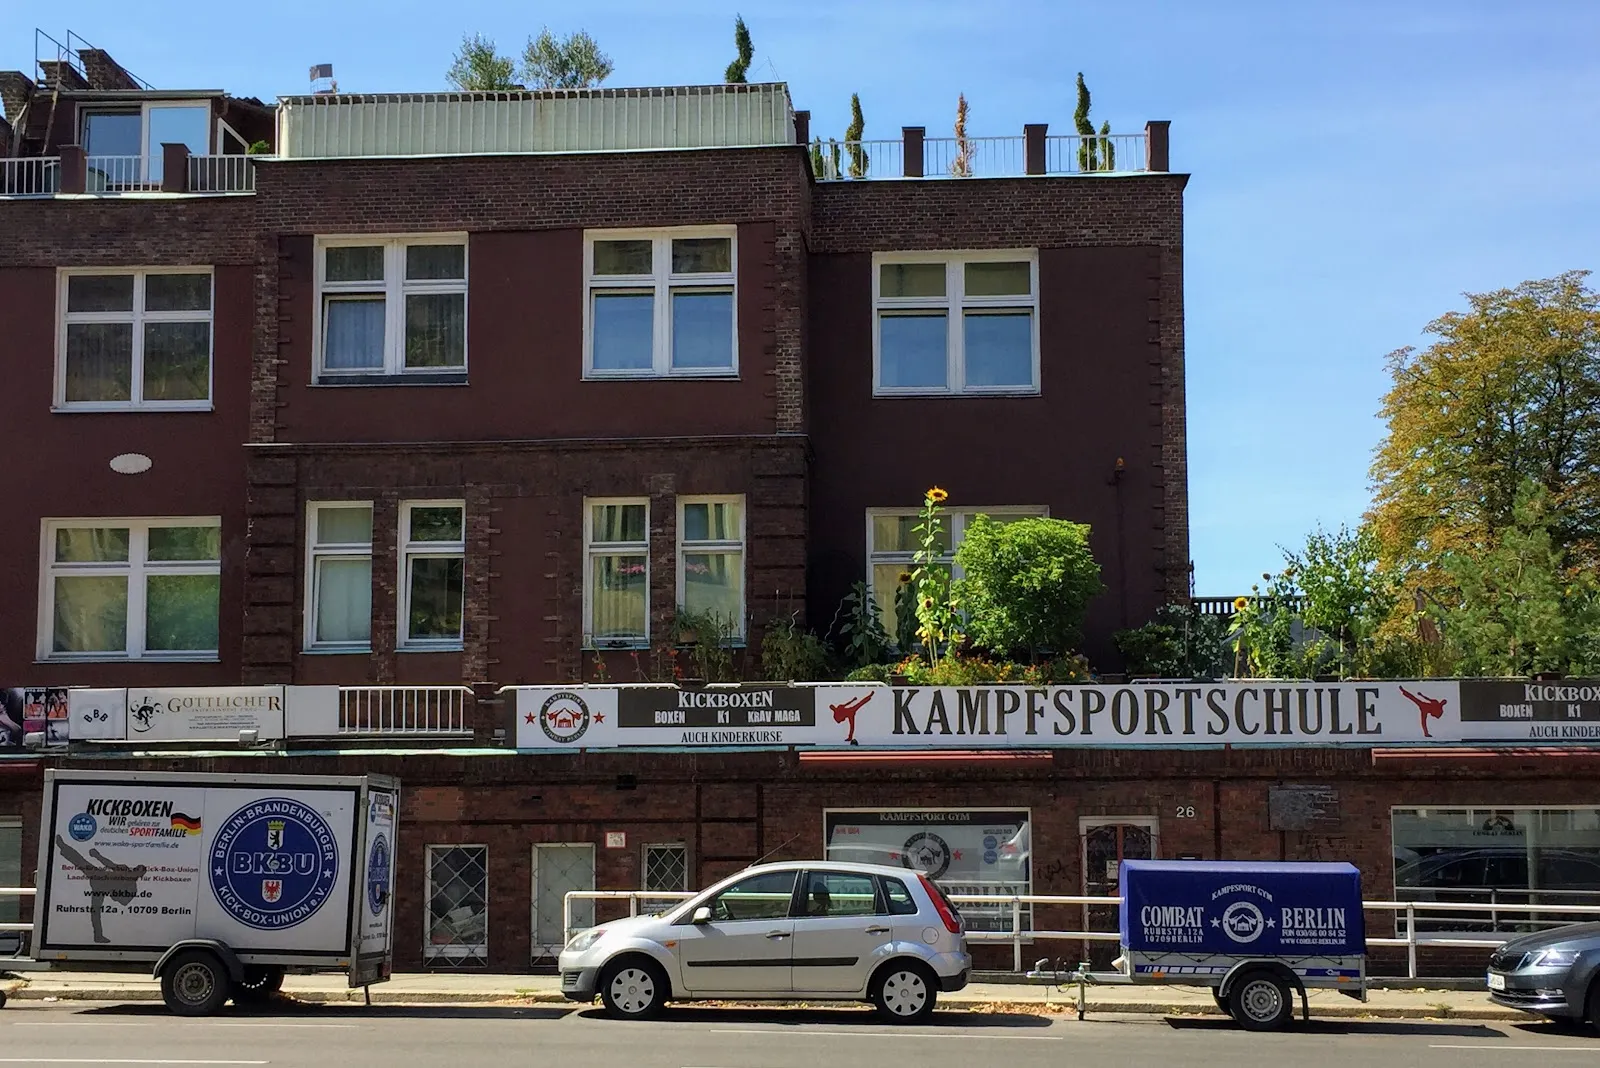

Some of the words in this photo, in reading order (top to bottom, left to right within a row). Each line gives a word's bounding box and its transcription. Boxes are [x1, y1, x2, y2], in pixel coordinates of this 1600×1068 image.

[677, 689, 774, 708] KICKBOXEN
[654, 710, 686, 724] BOXEN
[717, 710, 730, 724] K1
[747, 710, 772, 724] KRAV
[774, 709, 801, 723] MAGA
[891, 688, 1380, 736] KAMPFSPORTSCHULE
[1499, 704, 1533, 718] BOXEN
[1567, 704, 1582, 718] K1
[681, 731, 710, 744] AUCH
[711, 730, 783, 743] KINDERKURSE
[1529, 726, 1559, 738] AUCH
[86, 798, 174, 818] KICKBOXEN
[1176, 806, 1195, 818] 26
[108, 816, 127, 827] WIR
[879, 812, 947, 822] KAMPFSPORT
[948, 812, 971, 822] GYM
[129, 827, 187, 838] SPORTFAMILIE
[215, 802, 334, 861] BERLIN-BRANDENBURGER
[232, 851, 315, 876] BKBU
[153, 875, 191, 883] Kickboxen
[83, 889, 153, 899] www.bkbu.de
[1257, 888, 1273, 902] GYM
[56, 904, 95, 914] Ruhrstr.
[128, 905, 159, 915] 10709
[161, 906, 192, 917] Berlin
[218, 885, 311, 925] KICK-BOX-UNION
[1140, 905, 1204, 928] COMBAT
[1281, 907, 1346, 929] BERLIN
[1281, 929, 1295, 937] FON
